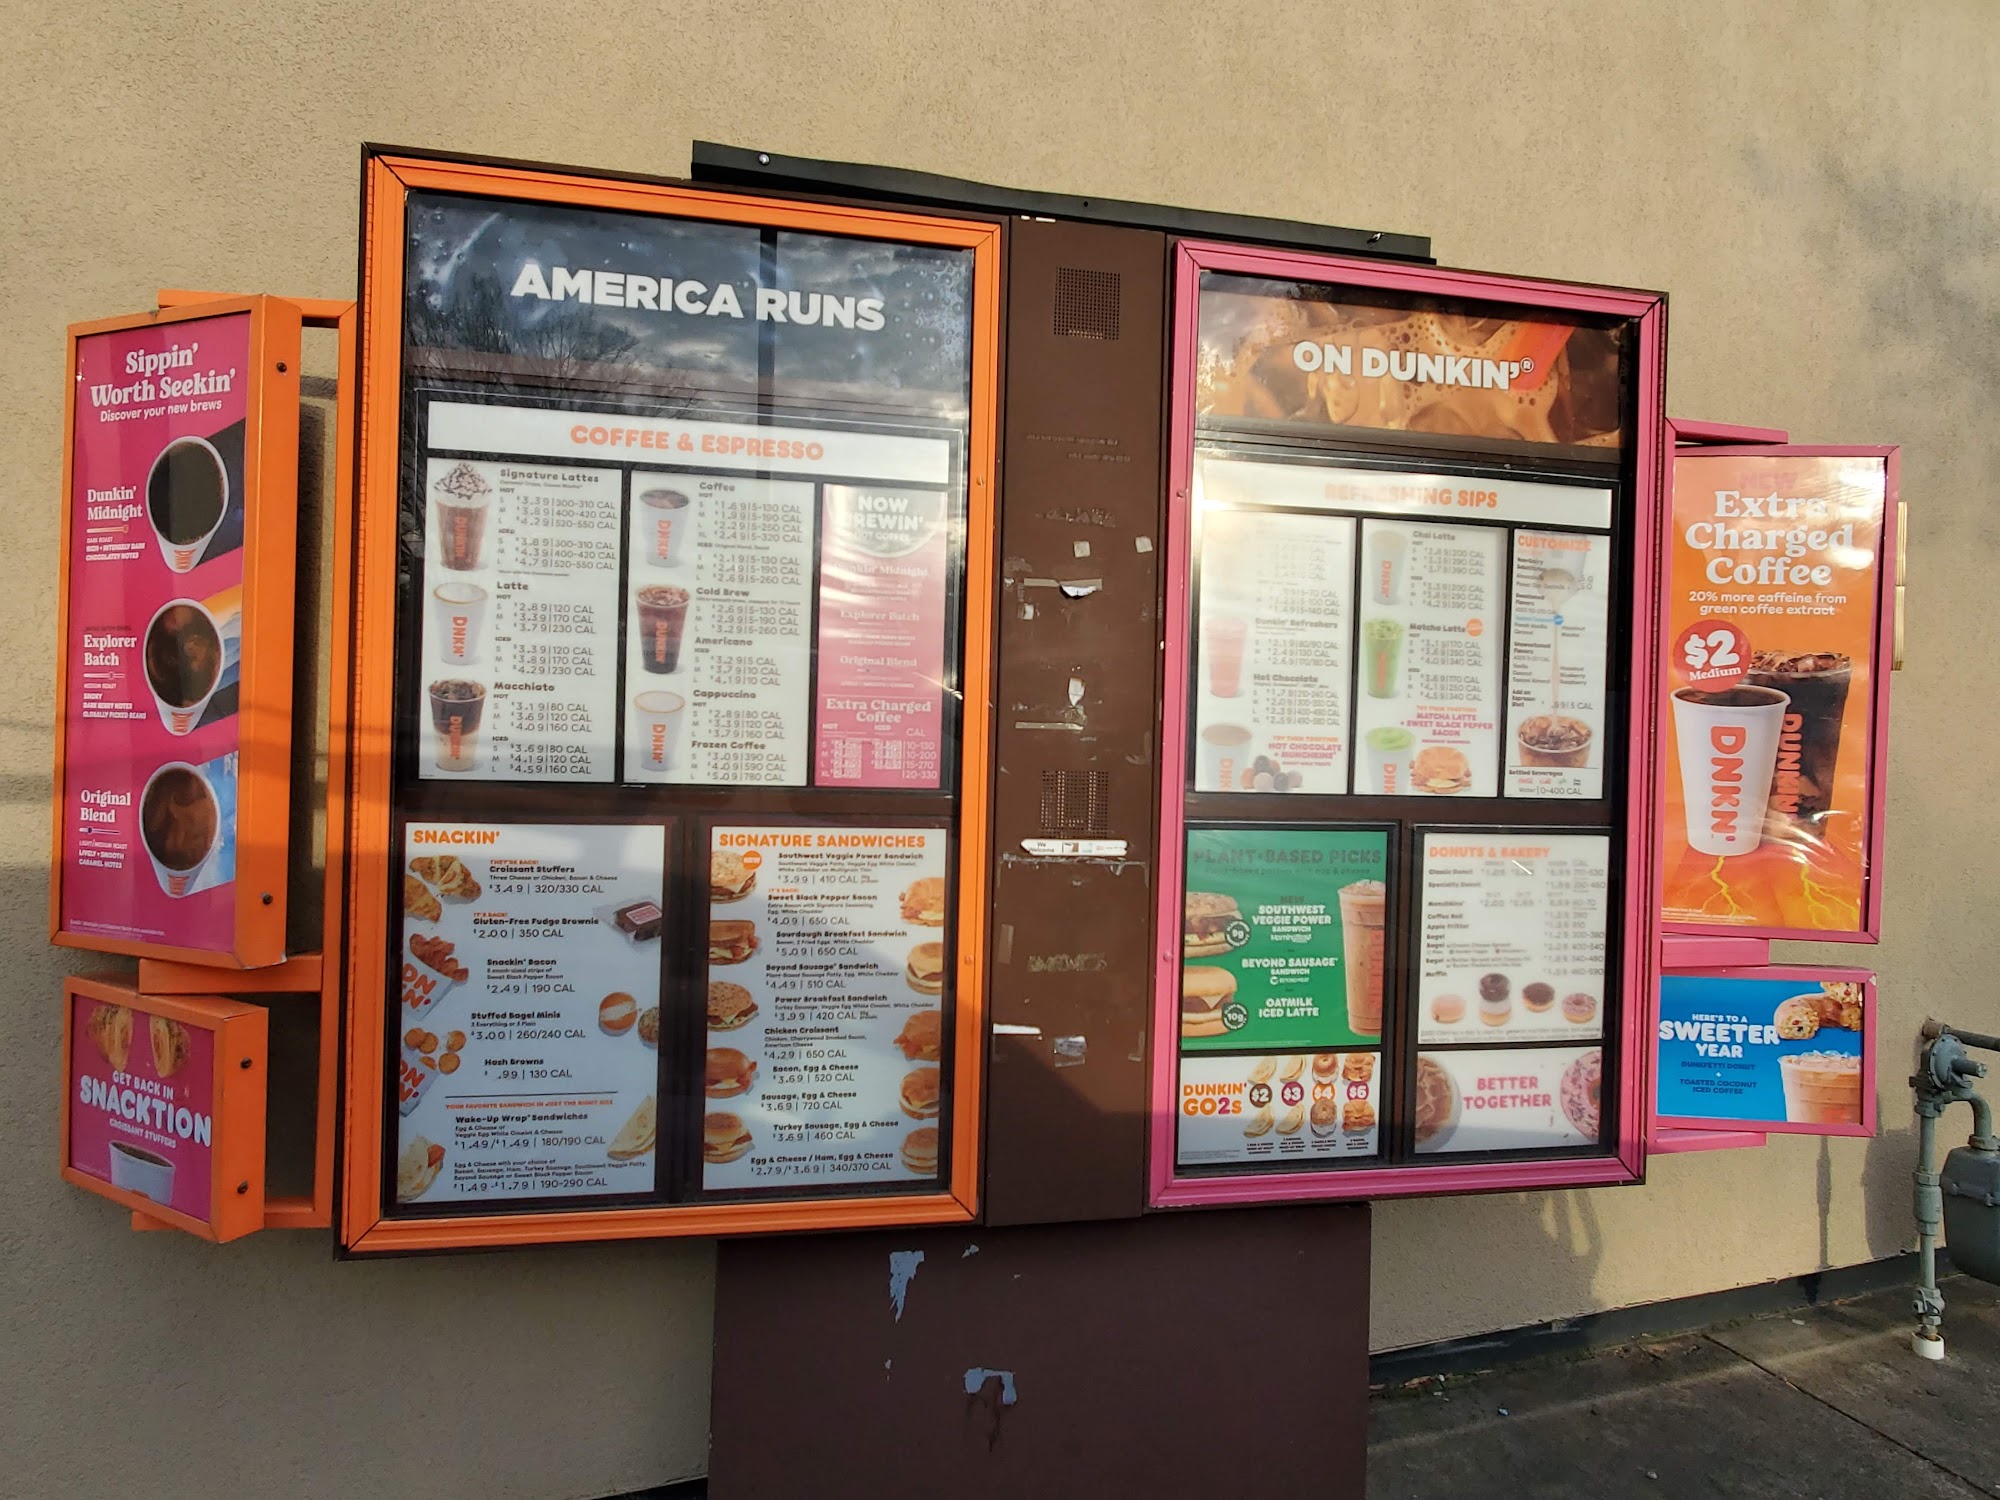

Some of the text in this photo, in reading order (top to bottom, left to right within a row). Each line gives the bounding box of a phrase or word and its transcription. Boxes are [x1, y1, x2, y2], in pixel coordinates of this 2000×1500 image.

[511, 264, 886, 331] AMERICA RUNS
[125, 342, 199, 377] Sippin'
[1293, 341, 1351, 375] ON
[91, 368, 236, 407] Worth Seekin'
[100, 399, 222, 422] Discover your new brews
[570, 425, 824, 461] COFFEE & ESPRESSO
[500, 469, 599, 483] Signature Lattes
[699, 482, 735, 492] Coffee
[87, 486, 136, 503] Dunkin'
[1458, 490, 1498, 509] SIPS
[1715, 490, 1828, 518] Extra
[87, 504, 143, 522] Midnight
[1685, 523, 1853, 558] Charged
[1706, 557, 1832, 585] Coffee
[497, 581, 529, 591] Latte
[696, 587, 750, 597] Cold Brew
[1689, 591, 1847, 604] 20% more caffeine from
[1700, 604, 1835, 616] green coffee extract
[83, 634, 137, 650] Explorer
[695, 637, 753, 646] Americano
[1684, 630, 1739, 668] $2
[83, 652, 119, 667] Batch
[1689, 666, 1741, 681] Medium
[494, 682, 555, 692] Macchiato
[693, 690, 756, 699] Cappuccino
[826, 698, 931, 713] Extra Charged
[856, 711, 902, 724] Coffee
[692, 741, 766, 750] Frozen Coffee
[80, 790, 131, 806] Original
[80, 808, 115, 823] Blend
[413, 830, 500, 844] SNACKIN'
[720, 834, 925, 847] SIGNATURE SANDWICHES
[826, 853, 853, 861] Veggie
[1330, 850, 1381, 864] PICKS
[537, 865, 575, 873] Stuffers
[535, 884, 604, 894] 320/330 CAL
[1259, 905, 1325, 914] SOUTHWEST
[474, 917, 529, 926] Gluten-Free
[532, 918, 560, 926] Fudge
[1252, 915, 1331, 925] VEGGIE POWER
[519, 929, 564, 938] 350 CAL
[777, 931, 821, 939] Sourdough
[487, 958, 556, 966] Snackin' Bacon
[766, 964, 796, 972] Beyond
[1242, 958, 1286, 968] BEYOND
[532, 984, 575, 993] 190 CAL
[1266, 998, 1313, 1007] OATMILK
[509, 1012, 535, 1021] Bagel
[1227, 1012, 1244, 1022] 10g
[1259, 1007, 1319, 1017] ICED LATTE
[1692, 1014, 1723, 1022] HERE'S
[517, 1029, 585, 1039] 260/240 CAL
[1659, 1021, 1781, 1045] SWEETER
[1696, 1043, 1743, 1058] YEAR
[485, 1058, 508, 1066] Hash
[530, 1069, 572, 1078] 130 CAL
[113, 1071, 173, 1100] GET BACK IN
[1184, 1082, 1247, 1096] DUNKIN'
[1477, 1076, 1539, 1090] BETTER
[1680, 1078, 1757, 1088] TOASTED COCONUT
[1251, 1089, 1270, 1102] $2
[1283, 1087, 1301, 1101] $3
[1314, 1087, 1333, 1100] $4
[1464, 1094, 1552, 1110] TOGETHER
[80, 1075, 211, 1147] SNACKTION
[456, 1112, 588, 1125] Wake-Up Sandwiches
[542, 1136, 605, 1146] 180/190 CAL
[830, 1164, 869, 1173] 340/370
[541, 1178, 607, 1189] 190-290 CAL
